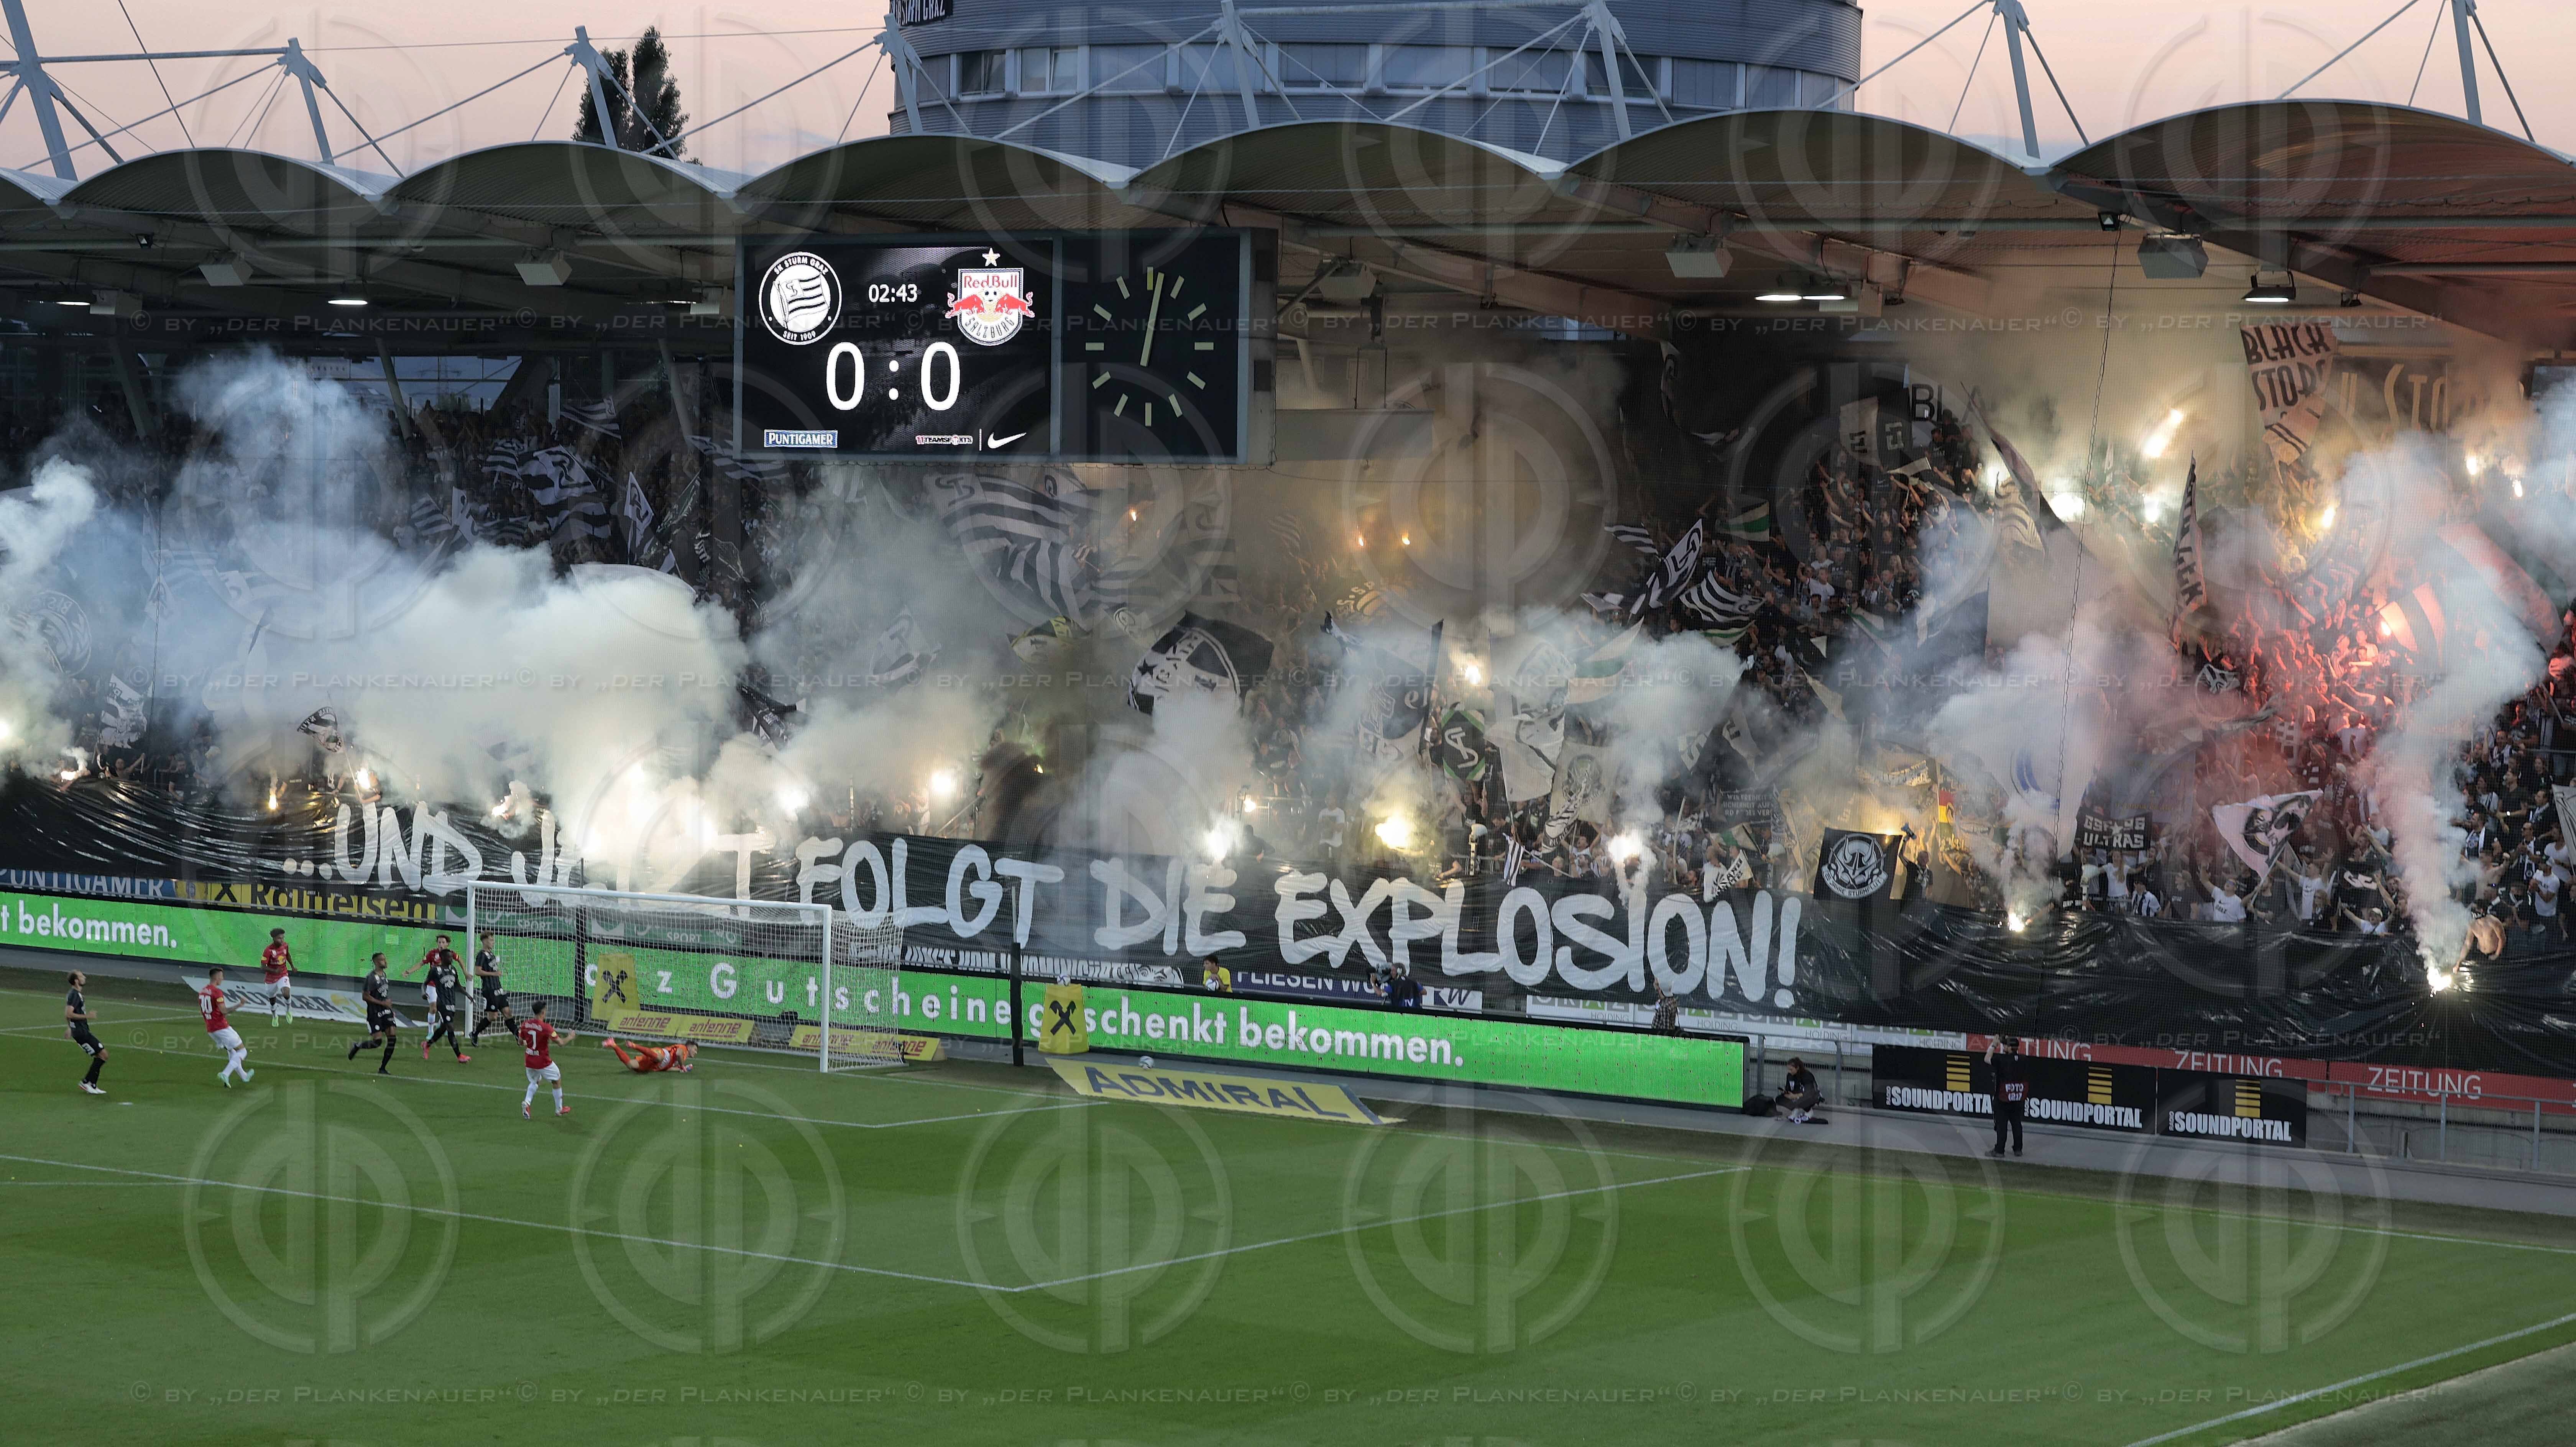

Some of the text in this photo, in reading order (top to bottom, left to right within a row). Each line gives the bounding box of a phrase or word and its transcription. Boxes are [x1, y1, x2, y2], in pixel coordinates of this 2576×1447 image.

[774, 256, 829, 275] SK STURM GRAZ
[964, 274, 1018, 289] Red Bull
[868, 284, 918, 302] 02:43
[782, 330, 816, 341] SEIT 1909
[965, 317, 1015, 338] SALZBURG
[2241, 322, 2331, 364] BLACK
[826, 342, 865, 411] 0
[921, 341, 960, 411] 0
[768, 432, 834, 446] PUNTIGAMER
[2083, 832, 2144, 848] ULTRAS
[18, 899, 177, 948] bekommen.
[517, 920, 553, 931] SPORT
[795, 835, 1065, 949] FOLGT
[1089, 857, 1247, 957] DIE
[1275, 870, 1802, 1009] EXPLOSION!
[666, 932, 702, 943] SPORT
[619, 1016, 671, 1029] antenne
[1590, 1011, 1629, 1022] HOLDING
[1697, 1019, 1739, 1031] HOLDING
[690, 1020, 742, 1034] antenne
[1028, 996, 1227, 1044] gschenkt
[1239, 1006, 1464, 1066] bekommen.
[2174, 1050, 2282, 1078] ZEITUNG
[1084, 1066, 1350, 1118] ADMIRAL
[2367, 1067, 2482, 1099] ZEITUNG
[1891, 1085, 1993, 1114] SOUNDPORTA
[2029, 1100, 2143, 1129] SOUNDPORTAL
[2174, 1111, 2292, 1142] SOUNDPORTAL
